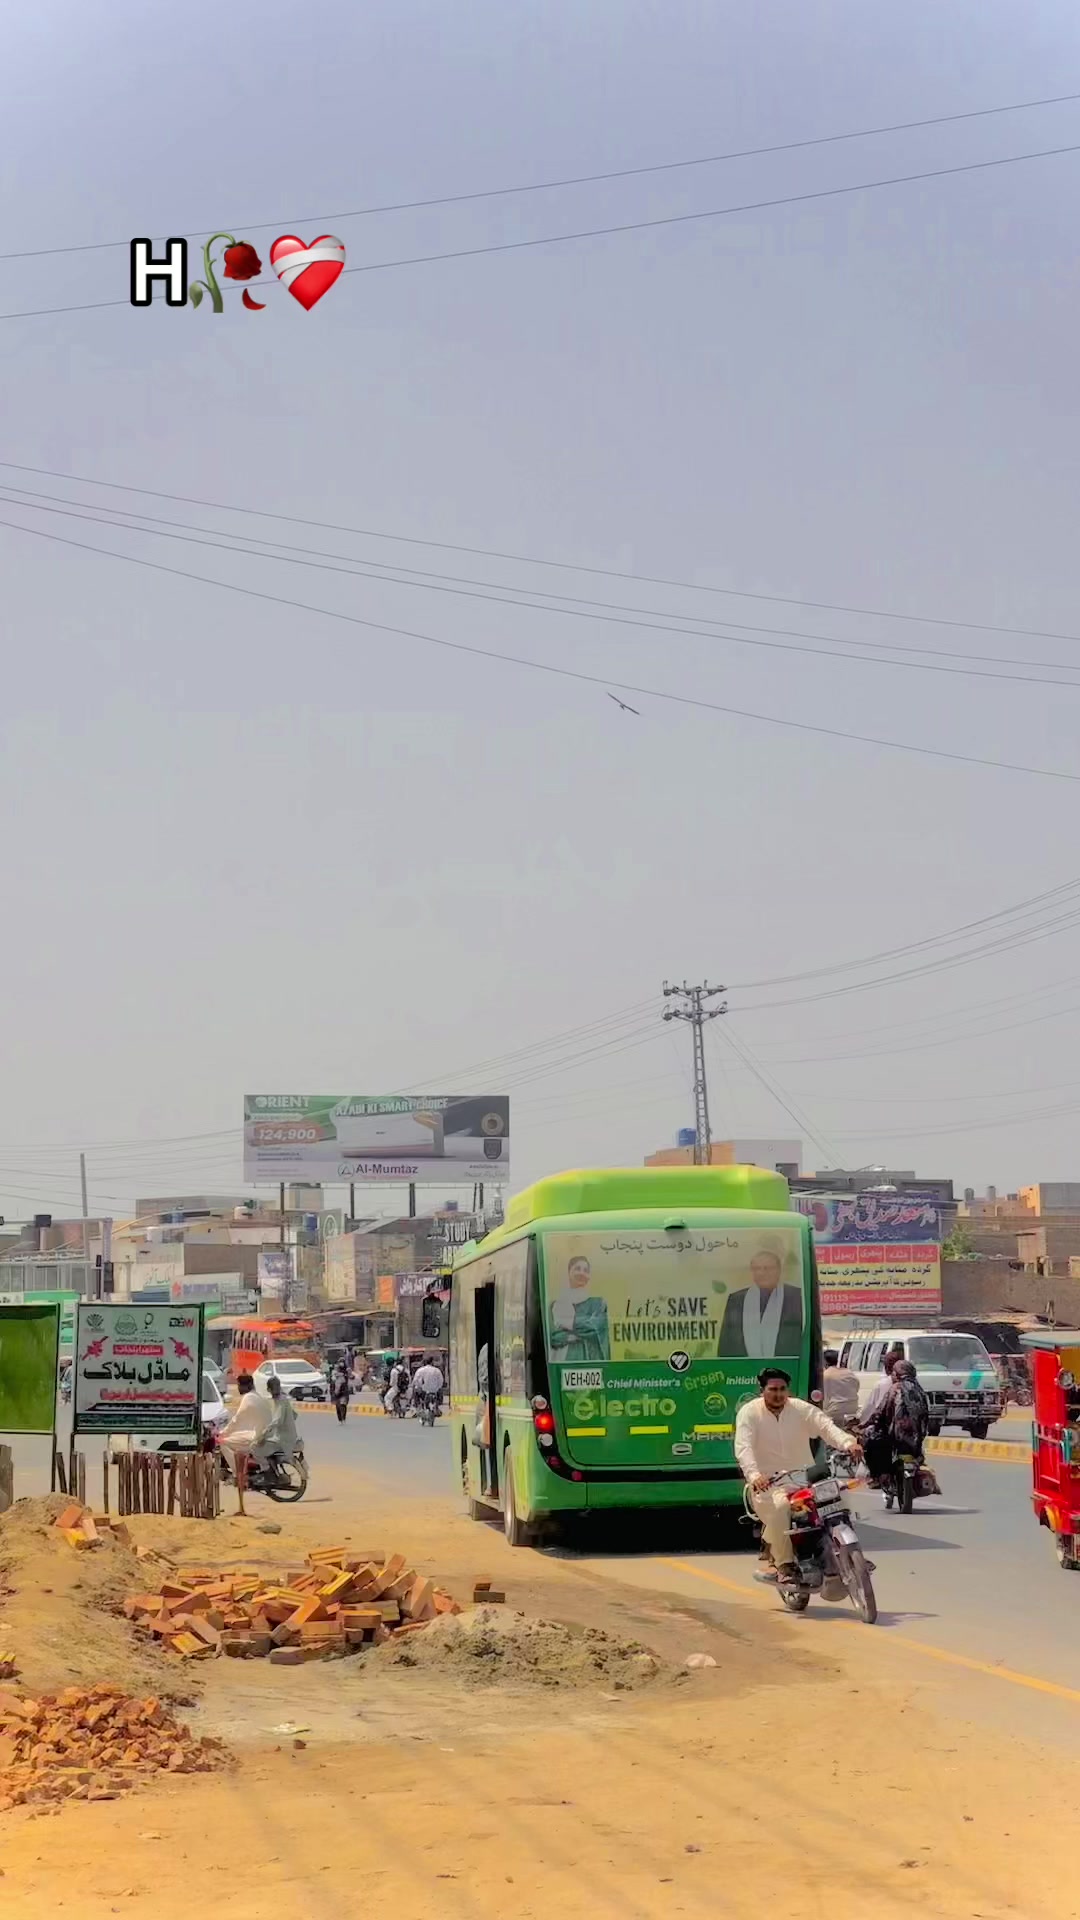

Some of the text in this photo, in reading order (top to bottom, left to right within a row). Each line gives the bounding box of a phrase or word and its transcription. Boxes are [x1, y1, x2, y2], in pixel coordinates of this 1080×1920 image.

[255, 1096, 310, 1108] ORIENT
[379, 1101, 413, 1113] SMART
[260, 1129, 316, 1141] 124,900
[356, 1163, 419, 1175] Al-Mumtaz
[444, 1220, 471, 1242] STUDY
[600, 1236, 739, 1255] ماحول دوست پنجاب
[625, 1297, 708, 1318] Let's SAVE
[612, 1320, 718, 1342] ENVIRONMENT
[83, 1358, 191, 1385] ماڈل بلاک
[564, 1371, 601, 1387] VEH-002
[606, 1377, 633, 1388] Chief
[634, 1376, 681, 1388] Minister's
[683, 1370, 725, 1391] Green
